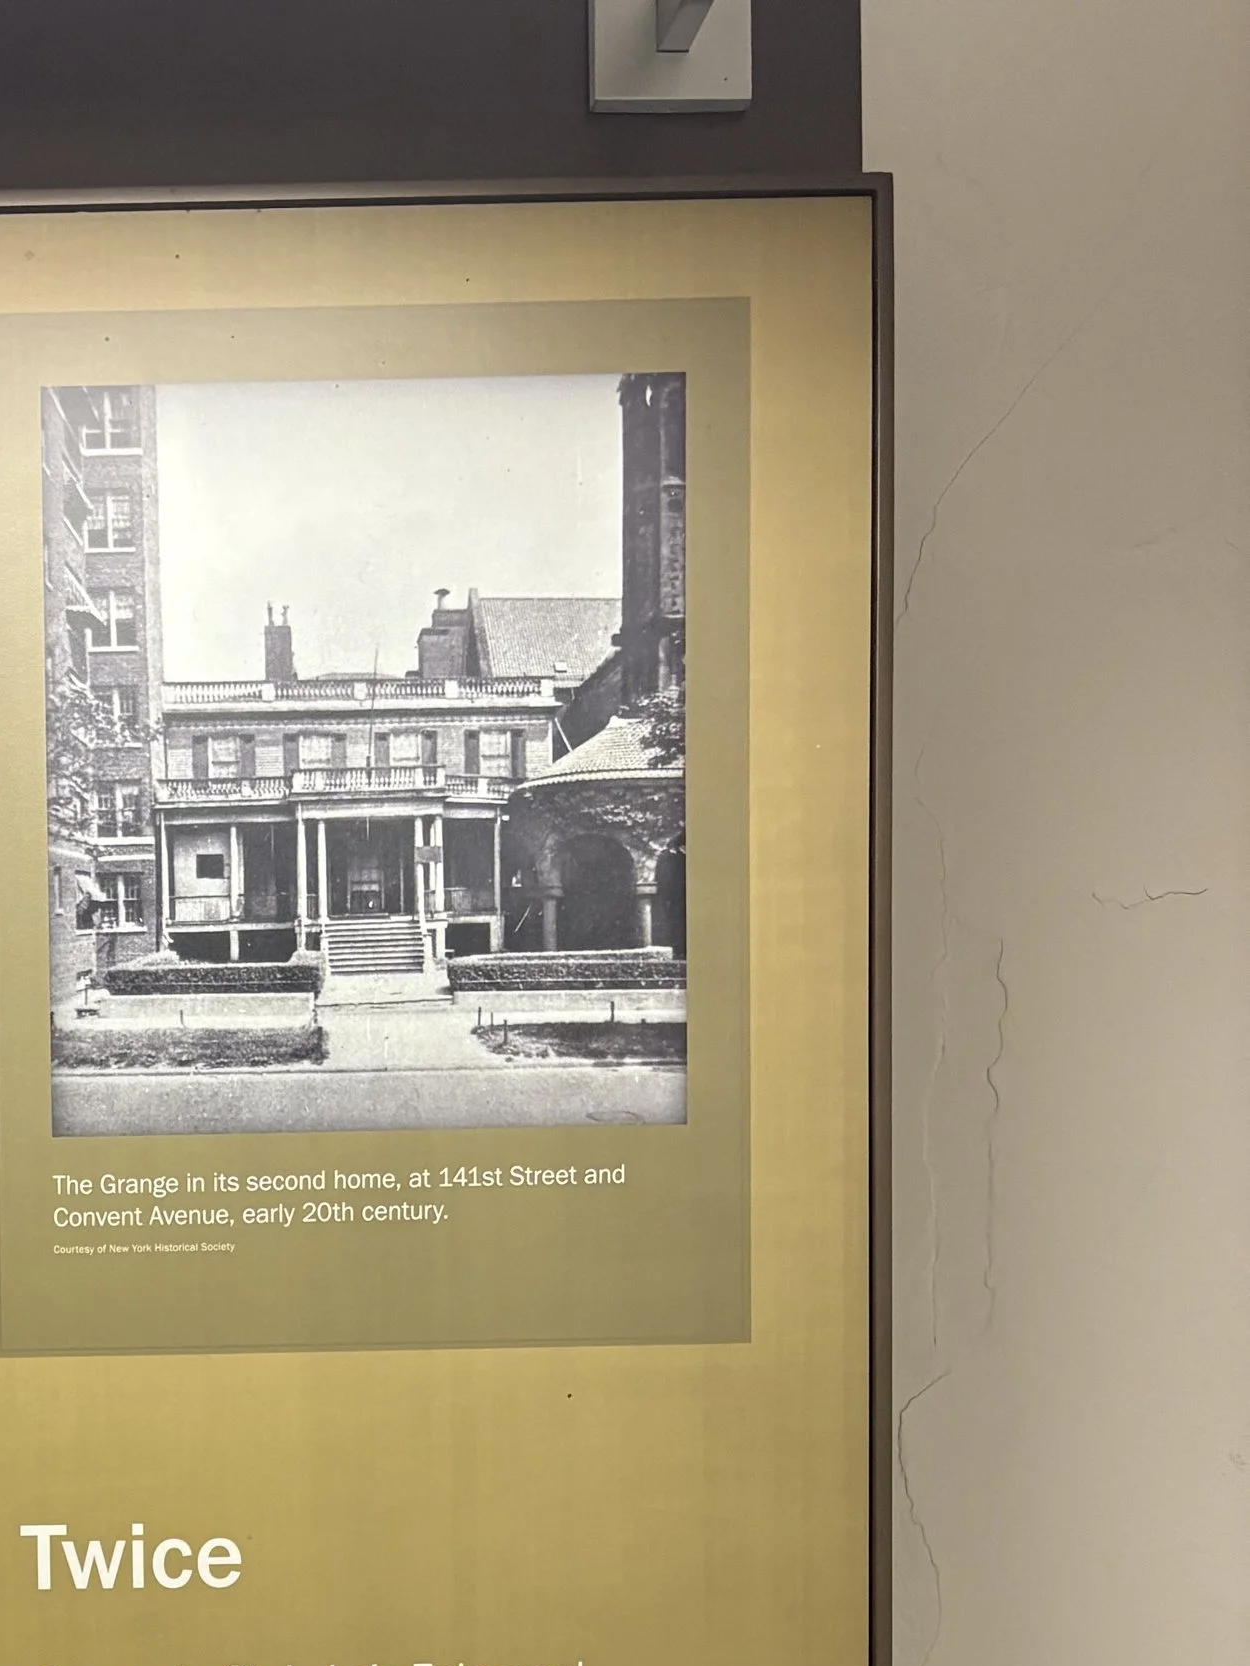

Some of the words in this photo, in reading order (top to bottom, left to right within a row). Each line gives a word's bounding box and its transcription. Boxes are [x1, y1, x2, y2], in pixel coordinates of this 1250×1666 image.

[52, 1175, 92, 1195] The
[100, 1174, 178, 1198] Grange
[187, 1173, 204, 1192] in
[214, 1172, 239, 1192] its
[246, 1170, 325, 1191] second
[335, 1170, 401, 1191] home,
[409, 1169, 431, 1188] at
[439, 1167, 503, 1187] 141st
[510, 1166, 577, 1186] Street
[584, 1164, 625, 1184] and
[54, 1207, 143, 1227] Convent
[149, 1206, 234, 1226] Avenue,
[243, 1203, 295, 1227] early
[302, 1202, 353, 1222] 20th
[362, 1202, 448, 1224] century.
[53, 1245, 94, 1255] Courtesy
[97, 1244, 107, 1253] of
[109, 1244, 129, 1253] New
[132, 1244, 152, 1253] York
[155, 1243, 198, 1252] Historical
[201, 1242, 235, 1252] Society
[20, 1523, 241, 1590] Twice
